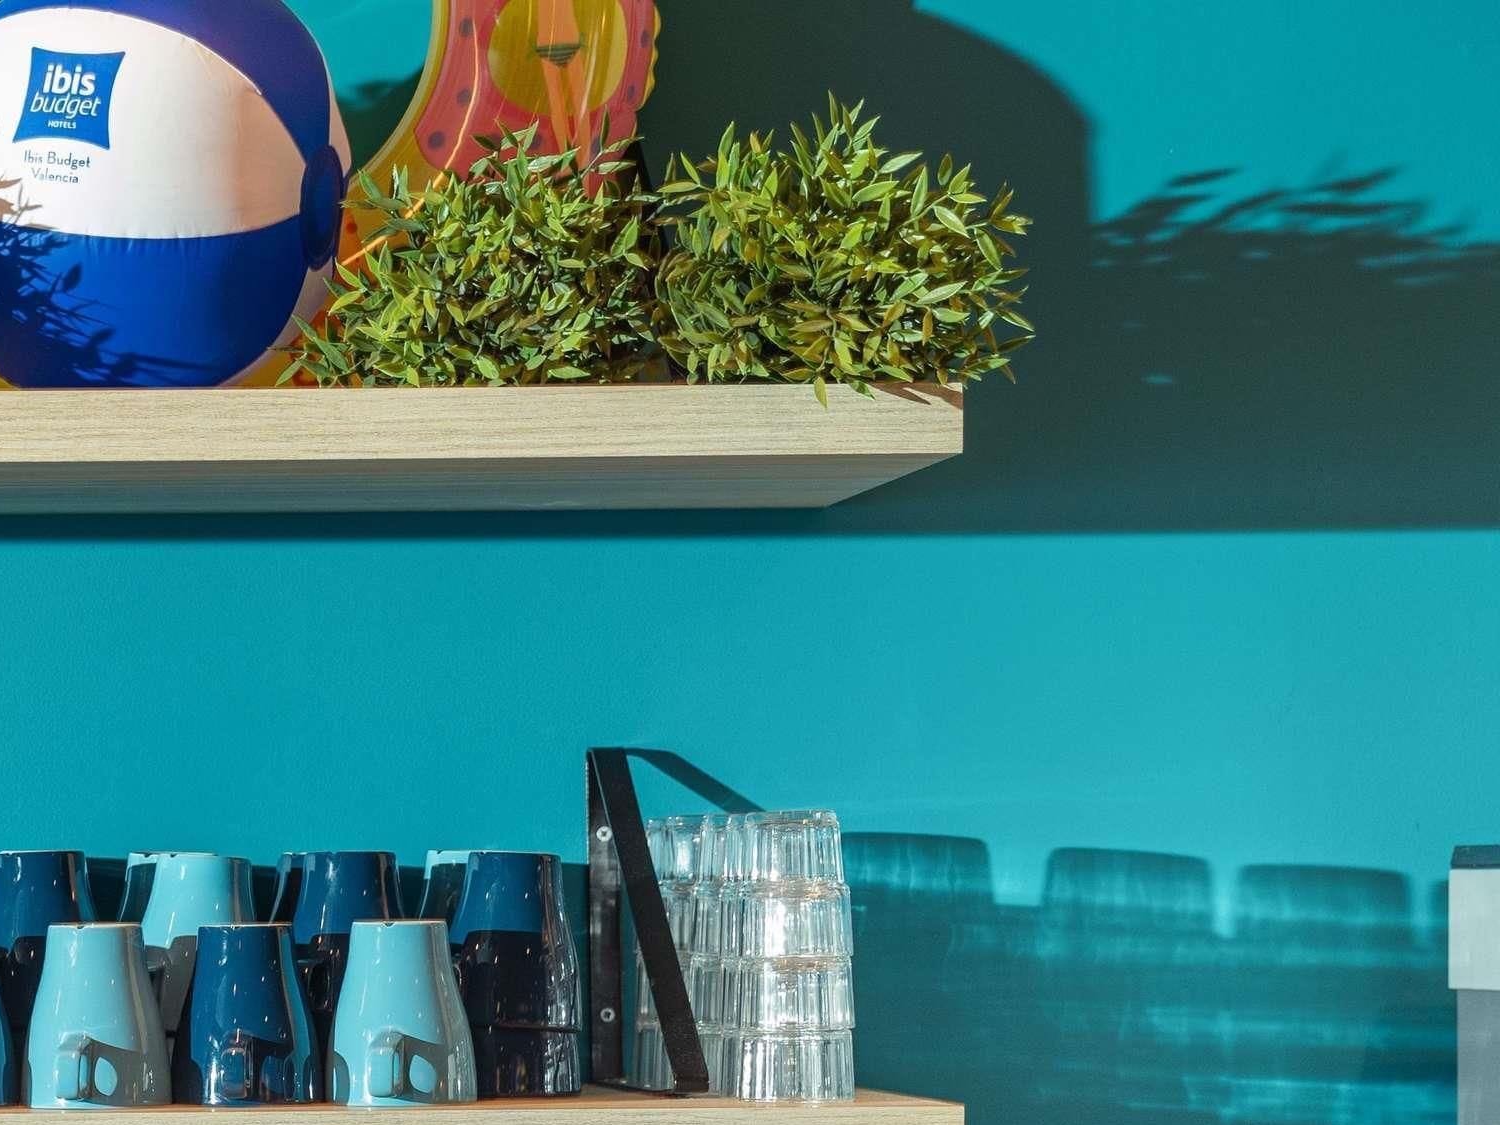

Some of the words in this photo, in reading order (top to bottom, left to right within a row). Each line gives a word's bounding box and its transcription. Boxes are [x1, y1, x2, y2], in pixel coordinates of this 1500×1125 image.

[42, 63, 96, 96] ibis
[30, 91, 101, 119] budget
[47, 120, 77, 129] HOTELS
[23, 150, 43, 163] Ibis
[47, 151, 91, 169] Budget
[32, 167, 79, 184] Valencia
